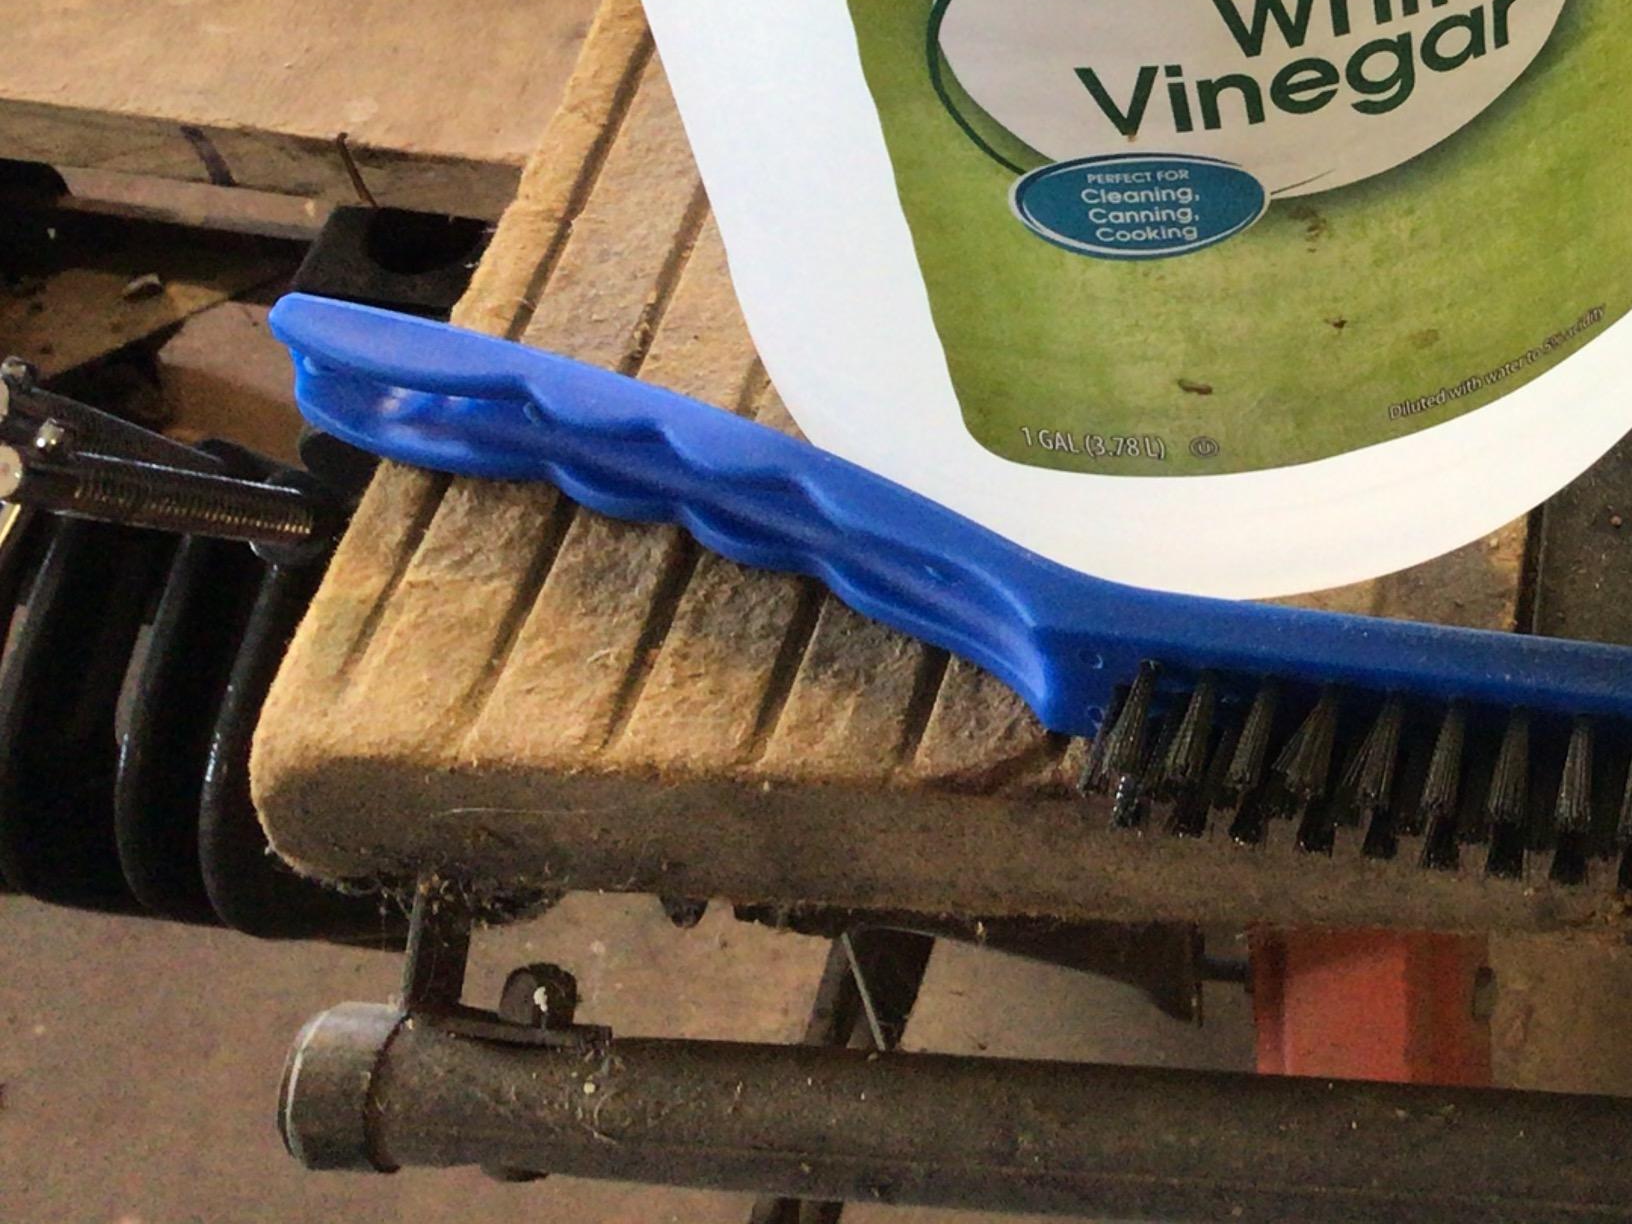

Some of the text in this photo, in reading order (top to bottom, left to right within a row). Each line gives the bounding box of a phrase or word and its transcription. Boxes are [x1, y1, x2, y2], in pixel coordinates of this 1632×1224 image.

[1087, 169, 1190, 185] PERFECT FOR
[1080, 186, 1200, 205] Cleaning,
[1088, 206, 1200, 225] Canning,
[1096, 225, 1199, 242] Cooking
[1388, 387, 1447, 421] Diluted
[1448, 375, 1483, 401] with
[1484, 357, 1524, 384] water
[1525, 349, 1541, 365] to
[1021, 427, 1166, 460] 1 GAL (3.78 L)
